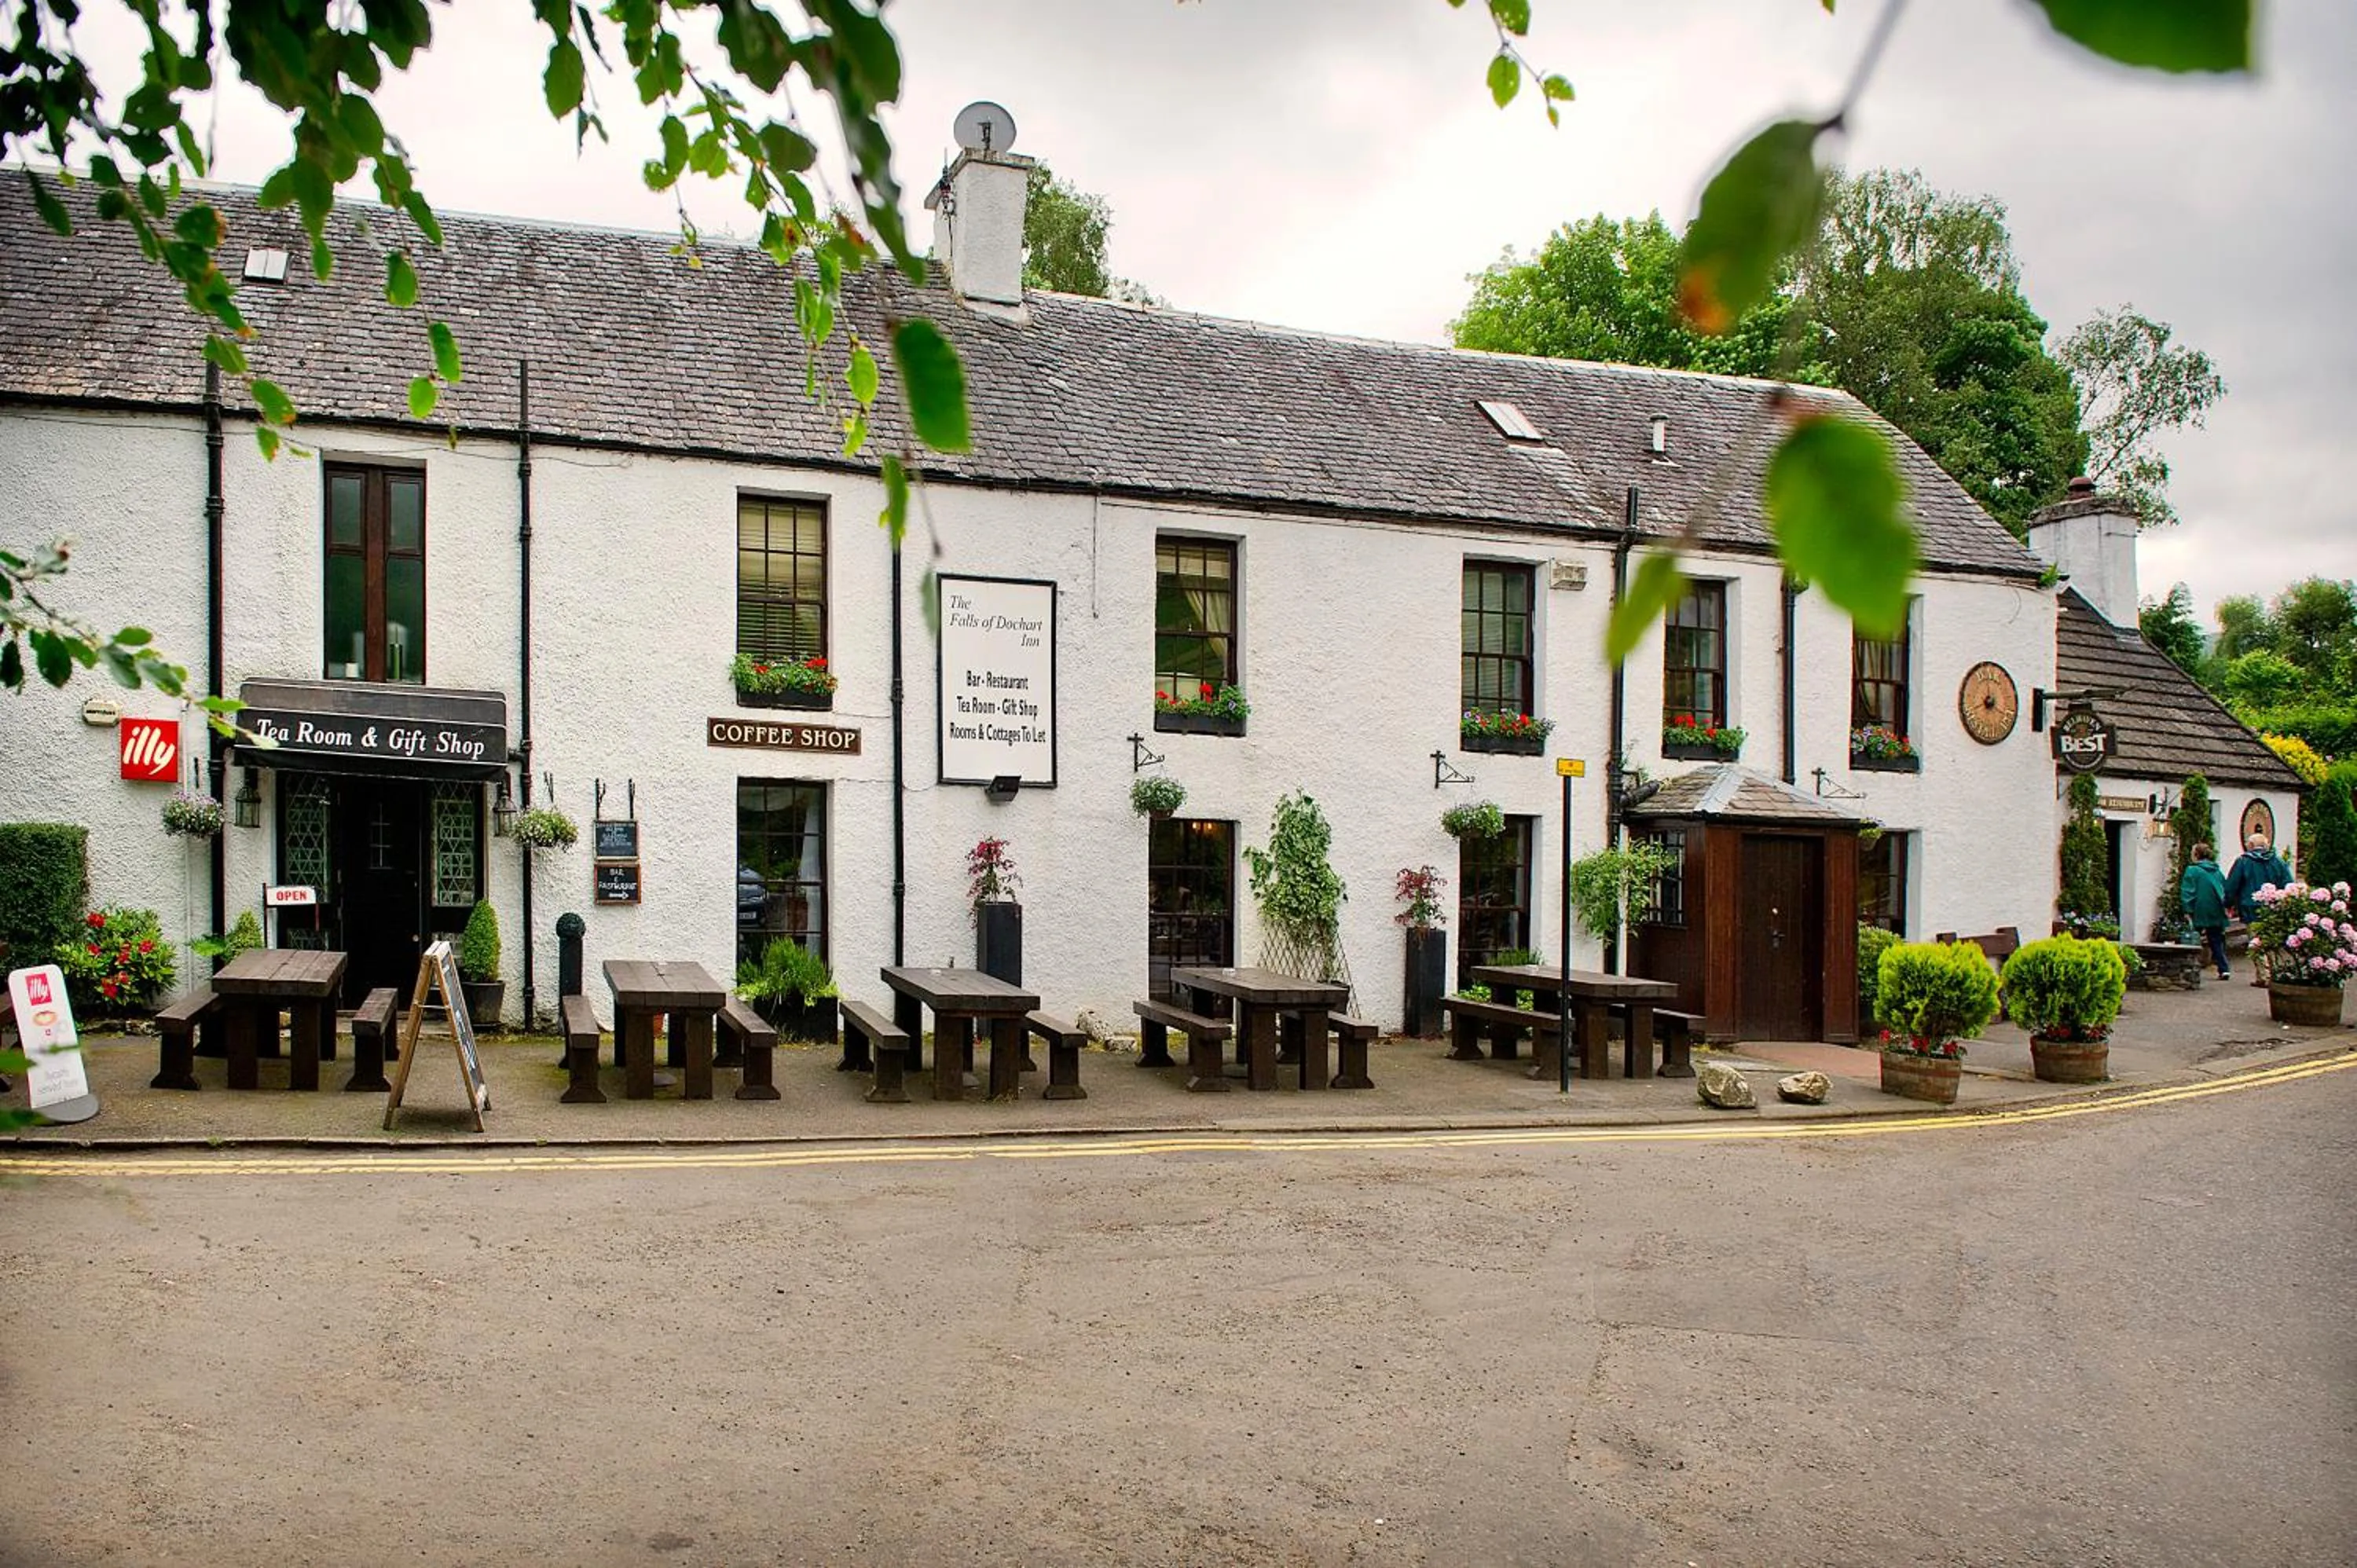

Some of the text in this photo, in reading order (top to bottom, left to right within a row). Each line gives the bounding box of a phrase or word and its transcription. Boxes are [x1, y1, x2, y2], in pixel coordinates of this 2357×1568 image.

[950, 595, 971, 610] The
[949, 613, 1043, 632] Falls of Dochart
[1021, 634, 1040, 647] Inn
[966, 670, 981, 687] Bar
[986, 671, 1028, 690] Restaurant
[956, 695, 971, 713] Tea
[972, 697, 995, 714] Room
[1002, 698, 1017, 716] Gift
[1019, 699, 1038, 721] Shop
[257, 718, 485, 760] Tea Room & Gift Shop
[713, 724, 856, 749] COFFEE SHOP
[950, 722, 1046, 746] Rooms & Cottages To Let
[2060, 732, 2107, 753] BEST
[123, 724, 175, 775] illy
[276, 890, 307, 901] OPEN
[29, 977, 49, 1002] illy
